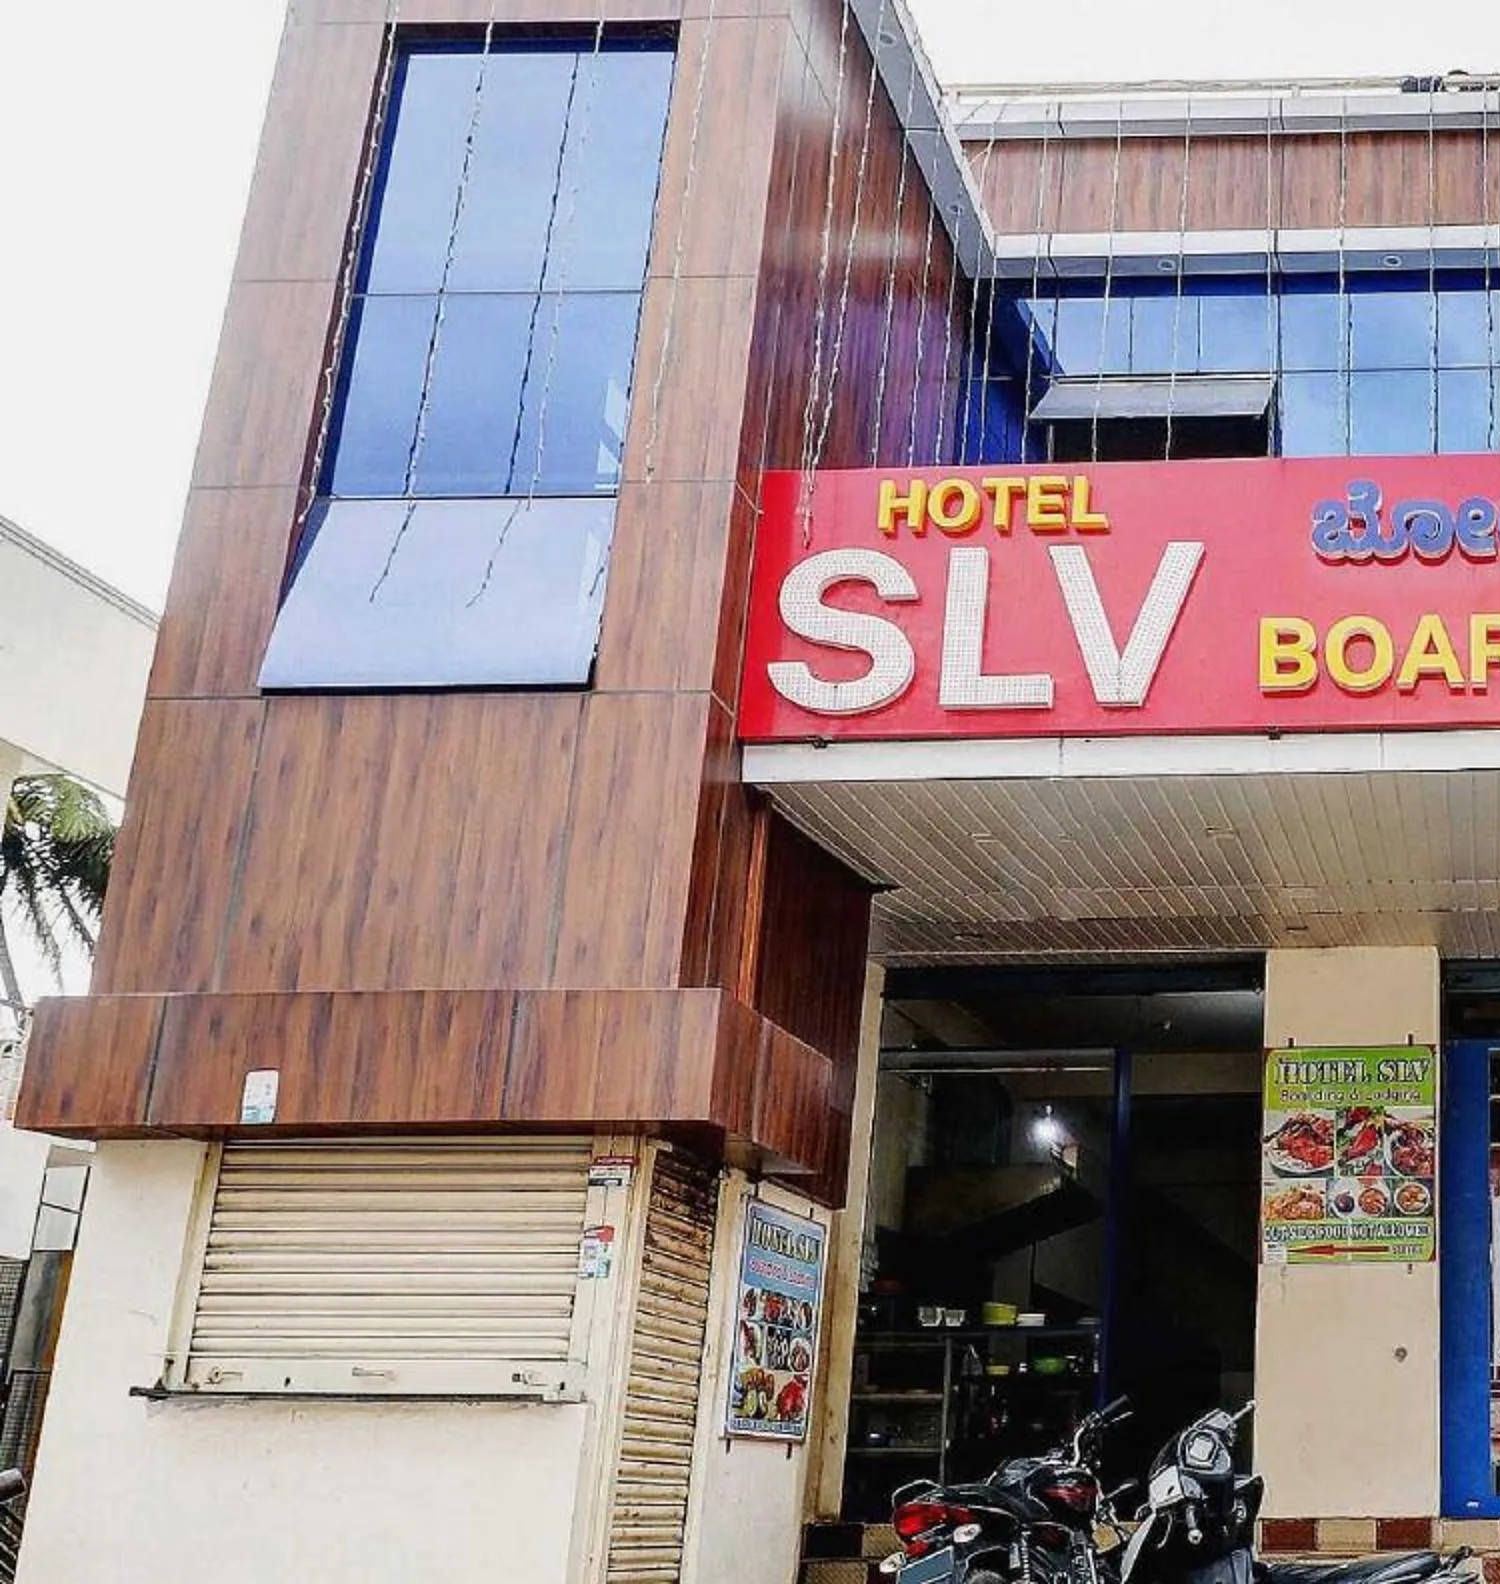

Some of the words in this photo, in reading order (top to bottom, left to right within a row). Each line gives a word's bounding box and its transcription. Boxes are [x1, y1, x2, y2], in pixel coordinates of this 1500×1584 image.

[877, 475, 1109, 533] HOTEL
[767, 541, 1205, 715] SLV
[1277, 1058, 1370, 1084] HOTEL
[1378, 1057, 1430, 1083] SLV
